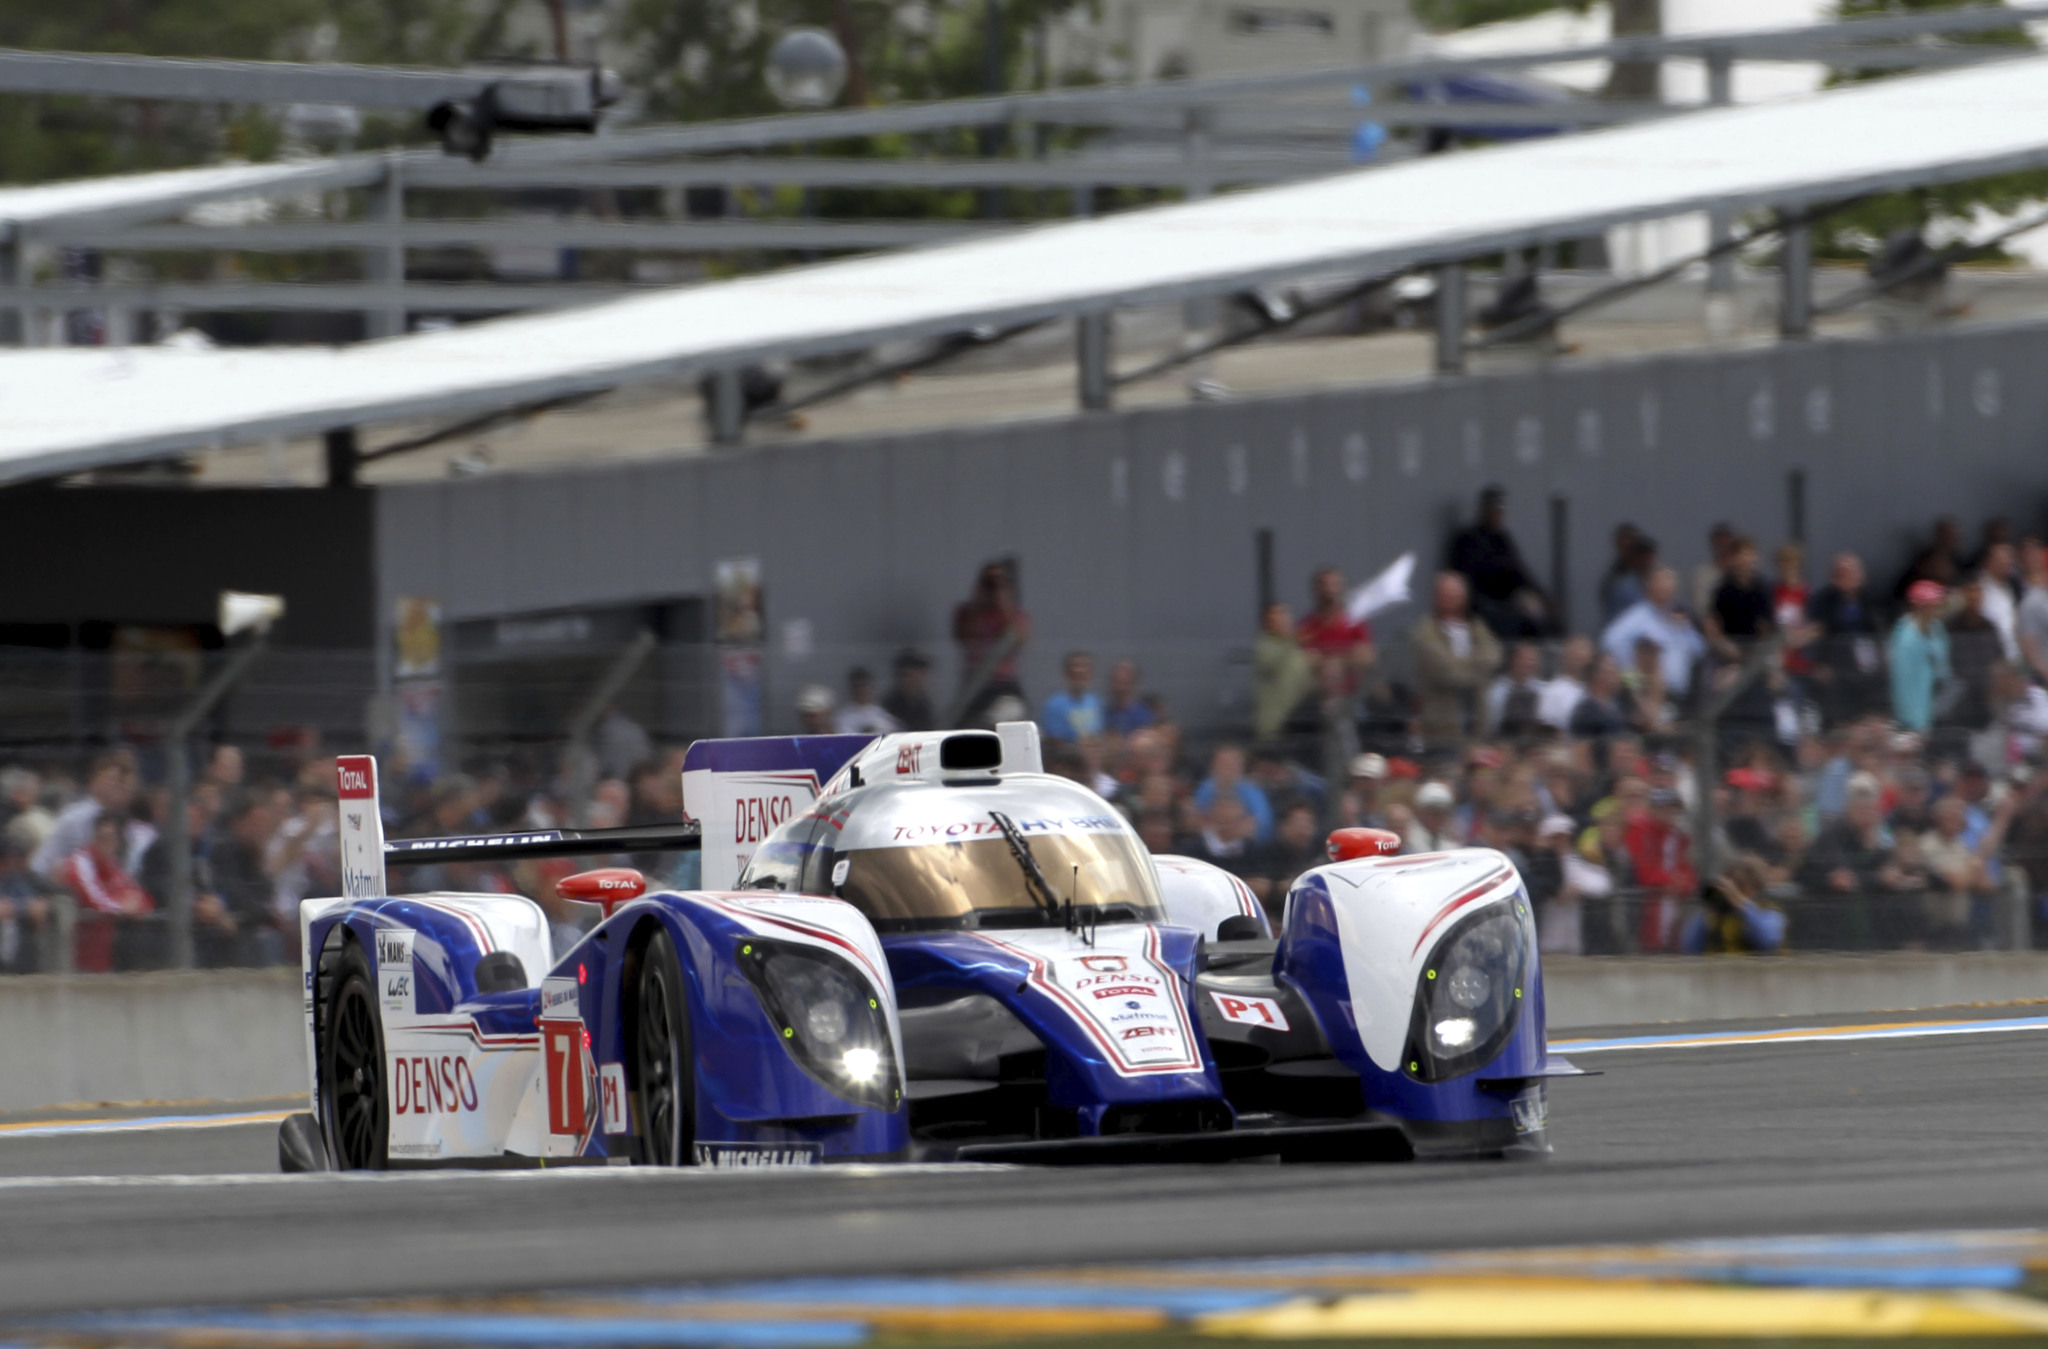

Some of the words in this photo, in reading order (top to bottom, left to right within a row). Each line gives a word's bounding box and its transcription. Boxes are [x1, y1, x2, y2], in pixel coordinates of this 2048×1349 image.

[896, 743, 922, 774] ZENT
[338, 766, 368, 790] TOTAL
[893, 821, 1001, 841] TOYOTA
[598, 879, 638, 889] TOTAL
[1076, 973, 1160, 990] DENSO
[1100, 986, 1155, 998] TOTAL
[1219, 998, 1275, 1024] P1
[1119, 1026, 1177, 1040] ZENT
[396, 1056, 479, 1115] DENSO
[554, 1035, 570, 1127] 7
[602, 1075, 620, 1123] P1
[717, 1150, 813, 1167] MICHELIN
